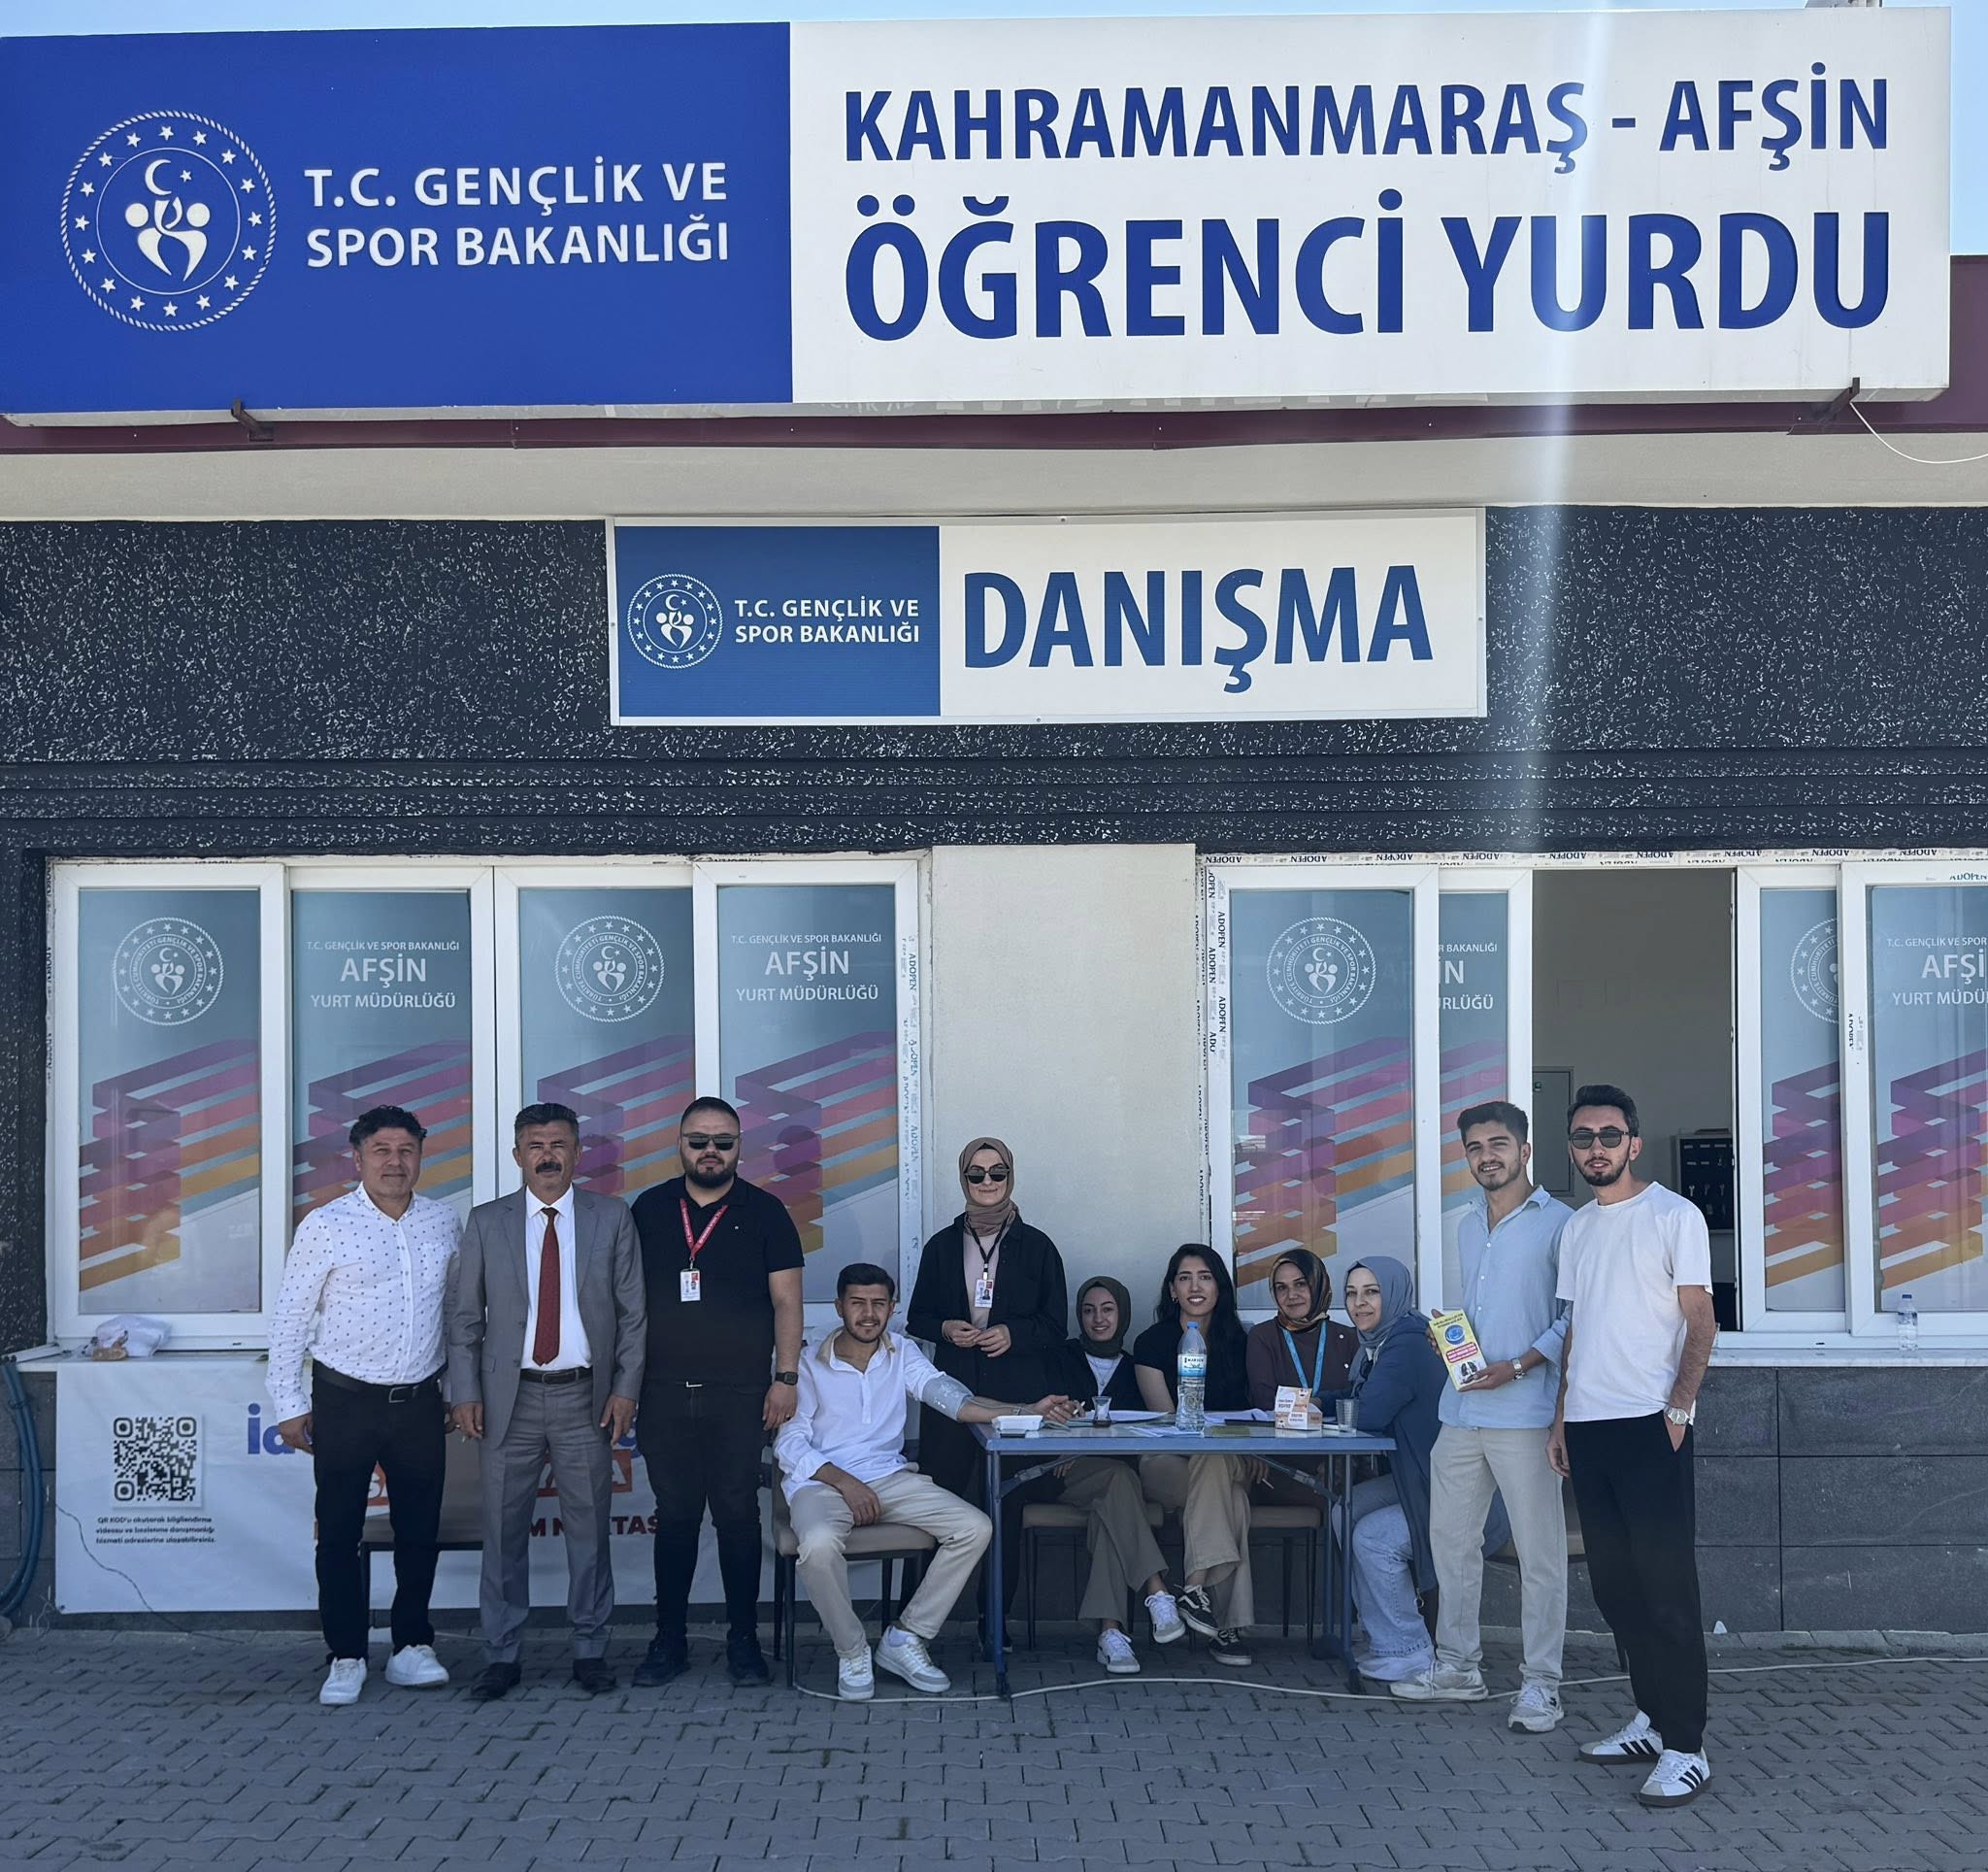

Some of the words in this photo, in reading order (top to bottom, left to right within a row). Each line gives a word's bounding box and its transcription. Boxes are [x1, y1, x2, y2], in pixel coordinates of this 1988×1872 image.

[845, 82, 1587, 175] KAHRAMANMARAŞ
[1659, 61, 1887, 172] AFŞİN
[304, 168, 396, 208] T.C.
[414, 155, 643, 217] GENÇLİK
[662, 162, 727, 201] VE
[307, 227, 439, 268] SPOR
[456, 214, 728, 266] BAKANLIĞI
[845, 188, 1404, 342] ÖĞRENCİ
[1441, 211, 1890, 333] YURDU
[734, 599, 776, 618] T.C.
[781, 595, 882, 622] GENÇLİK
[889, 599, 919, 618] VE
[735, 624, 793, 644] SPOR
[801, 618, 919, 643] BAKANLIĞI
[964, 564, 1434, 694] DANIŞMA
[325, 939, 365, 953] GENÇLİK
[408, 938, 459, 951] BAKANLIĞI
[749, 933, 789, 946] GENÇLİK
[790, 934, 802, 943] VE
[805, 934, 829, 943] SPOR
[831, 932, 881, 943] BAKANLIĞI
[1446, 942, 1497, 952] BAKANLIĞI
[1887, 938, 1904, 947] T.C.
[1905, 936, 1946, 948] GENÇLİK
[1963, 937, 1987, 946] SPOR
[340, 953, 426, 988] AFŞİN
[765, 946, 849, 982] AFŞİN
[311, 994, 351, 1008] YURT
[355, 992, 456, 1008] MÜDÜRLÜĞÜ
[736, 988, 777, 1002] YURT
[779, 985, 878, 1002] MÜDÜRLÜĞÜ
[1893, 992, 1934, 1006] YURT
